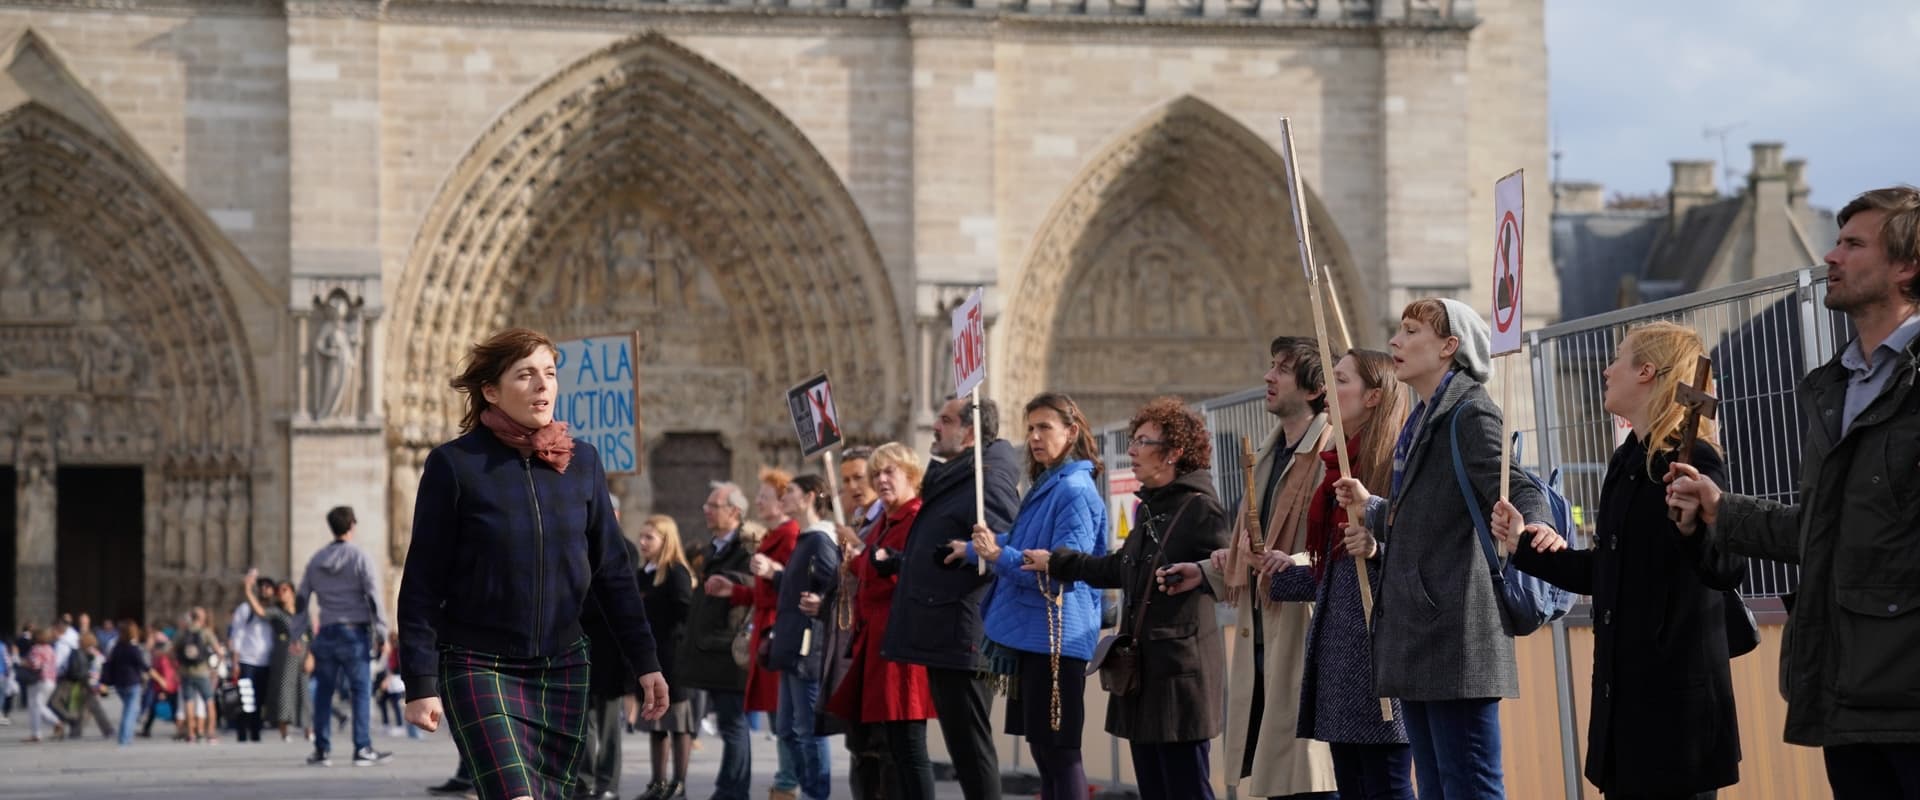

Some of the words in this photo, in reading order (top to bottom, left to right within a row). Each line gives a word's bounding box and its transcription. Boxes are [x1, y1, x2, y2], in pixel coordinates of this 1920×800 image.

[577, 338, 598, 385] À
[603, 342, 633, 382] LA
[554, 389, 634, 431] UCTION
[576, 431, 633, 471] URS
